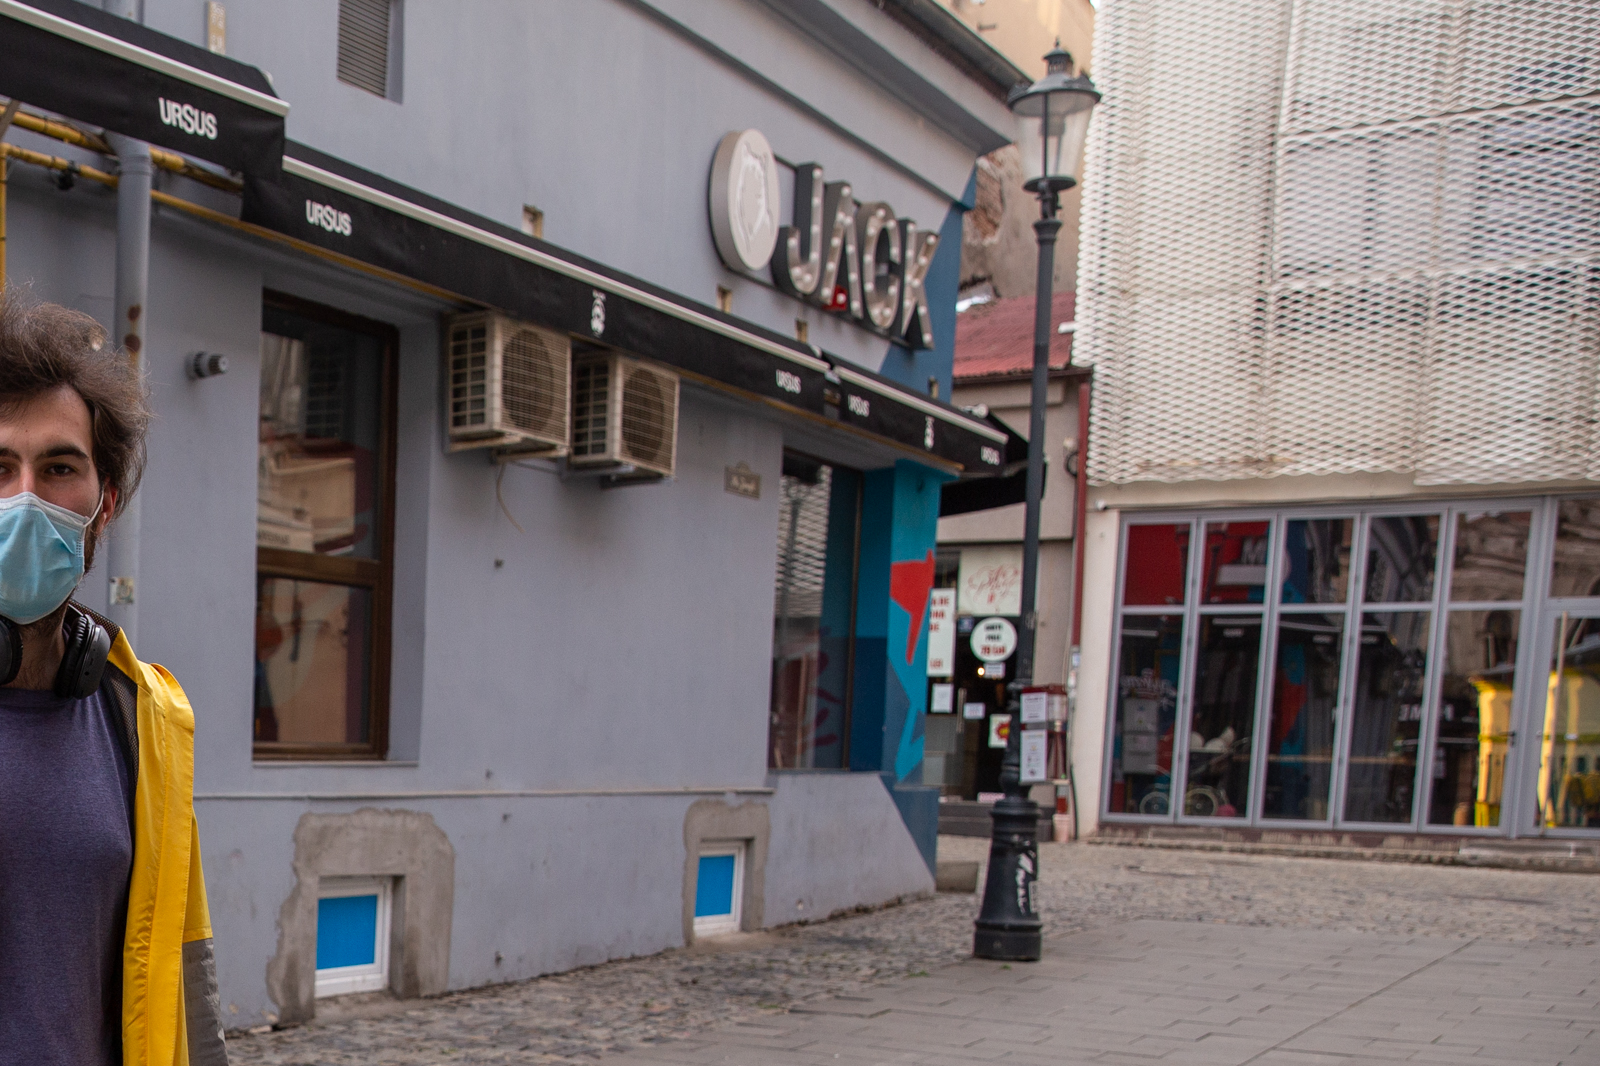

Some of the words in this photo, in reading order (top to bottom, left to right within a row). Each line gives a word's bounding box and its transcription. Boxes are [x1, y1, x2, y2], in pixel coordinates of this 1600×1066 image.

[158, 97, 218, 140] URSUS
[306, 199, 352, 236] URSUS
[771, 162, 941, 350] JACK
[776, 369, 801, 394] URSUS
